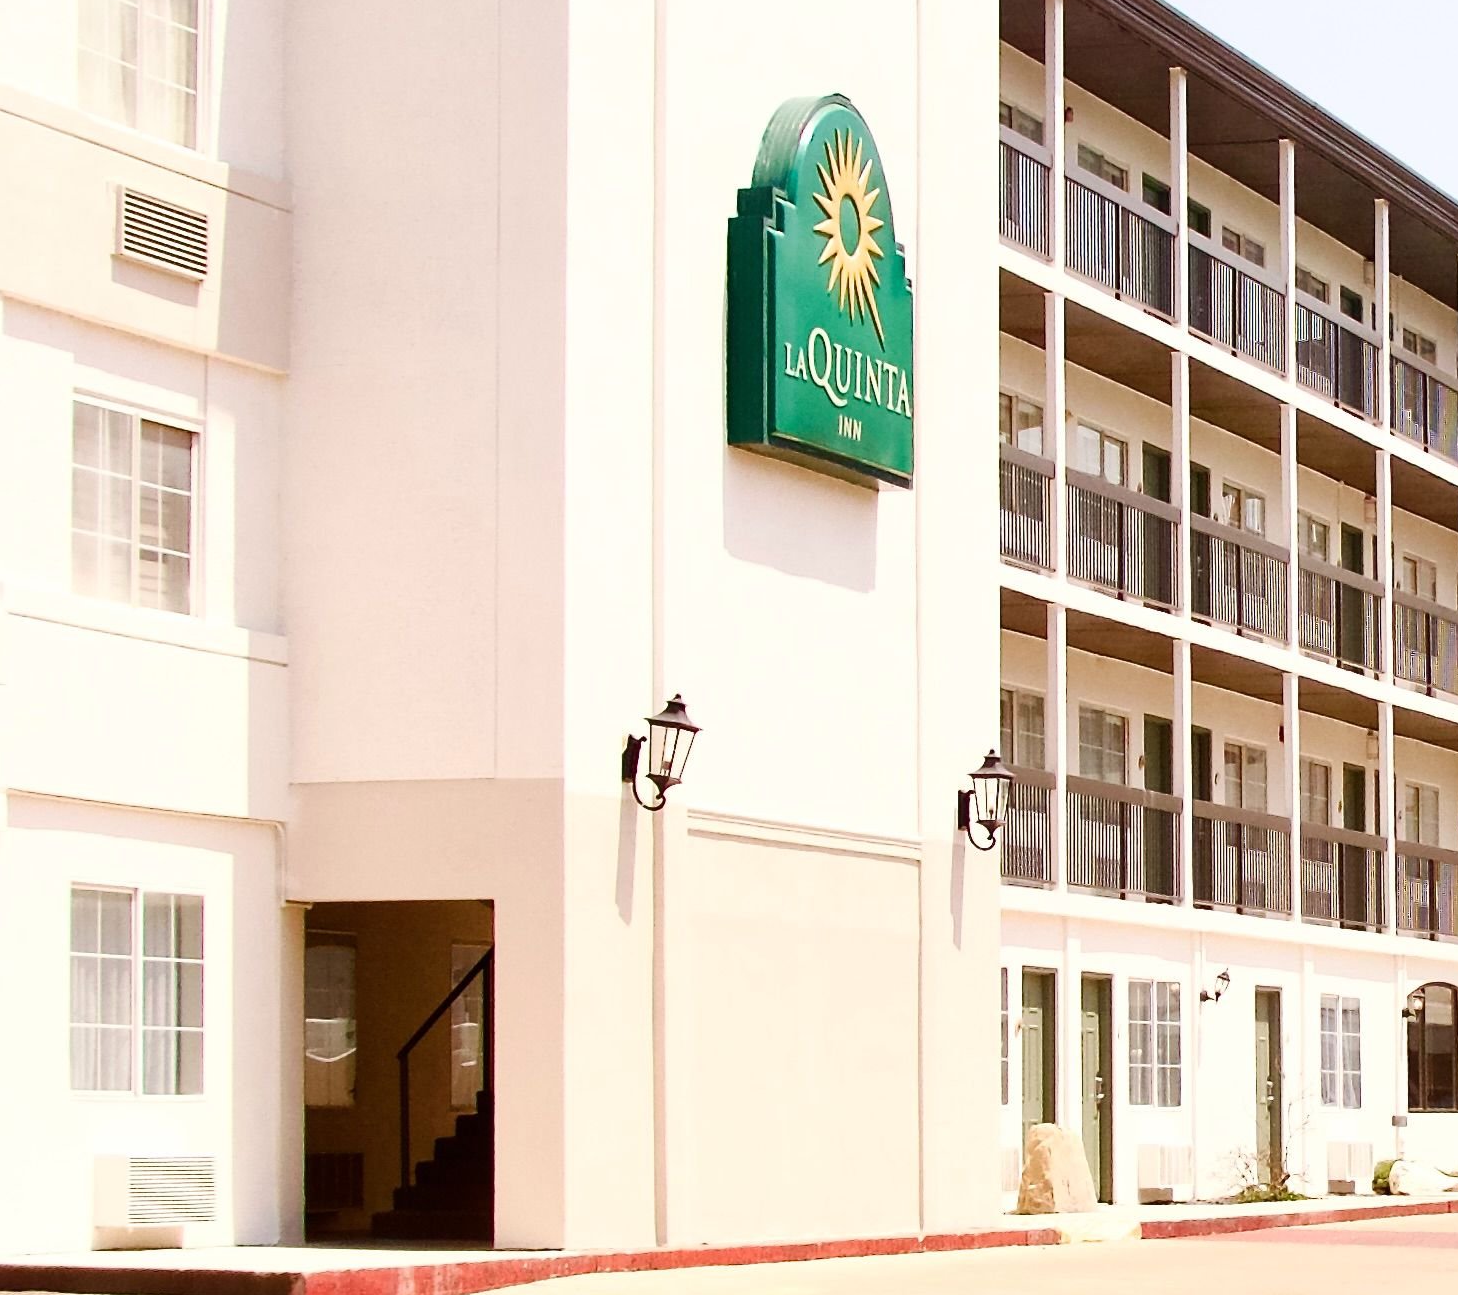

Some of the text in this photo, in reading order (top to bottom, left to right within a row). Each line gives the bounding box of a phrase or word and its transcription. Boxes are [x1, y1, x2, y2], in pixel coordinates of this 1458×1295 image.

[784, 327, 912, 417] LA QUINTA
[838, 414, 862, 441] INN
